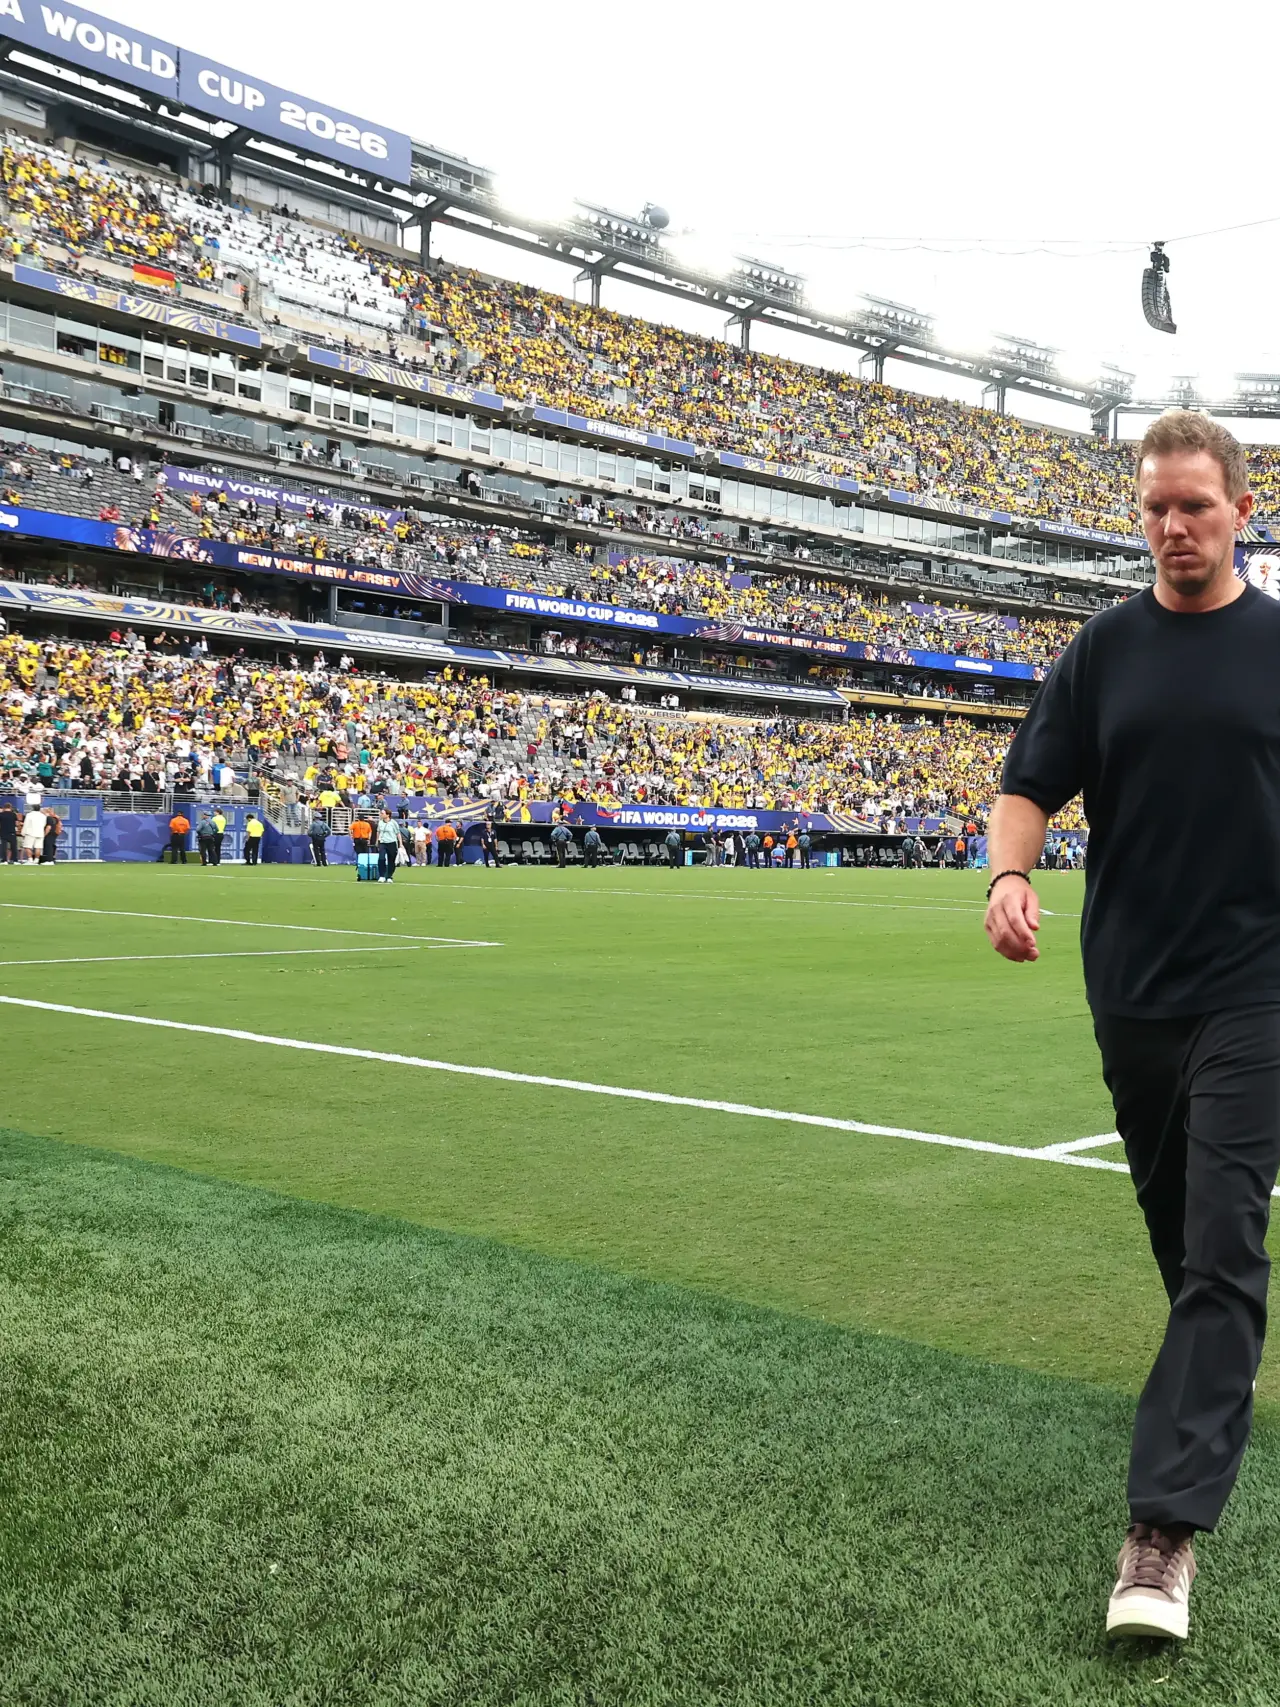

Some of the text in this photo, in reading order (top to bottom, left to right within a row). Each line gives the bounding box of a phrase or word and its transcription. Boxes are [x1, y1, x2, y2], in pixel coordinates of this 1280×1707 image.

[40, 5, 176, 79] WORLD
[198, 70, 266, 111] CUP
[279, 101, 388, 159] 2026
[178, 471, 223, 489] NEW
[227, 481, 280, 500] YORK
[1044, 523, 1065, 532] NEW
[1066, 527, 1090, 537] YORK
[1091, 532, 1111, 541] NEW
[238, 551, 400, 588] NEW YORK NEW JERSEY
[506, 594, 537, 611] FIFA
[537, 598, 586, 617] WORLD
[587, 607, 614, 621] CUP
[743, 630, 848, 653] NEW YORK NEW JERSEY
[689, 676, 720, 686] FIFA
[720, 679, 766, 691] WORLD
[650, 710, 688, 719] JERSEY
[643, 812, 689, 826] WORLD
[690, 813, 715, 827] CUP
